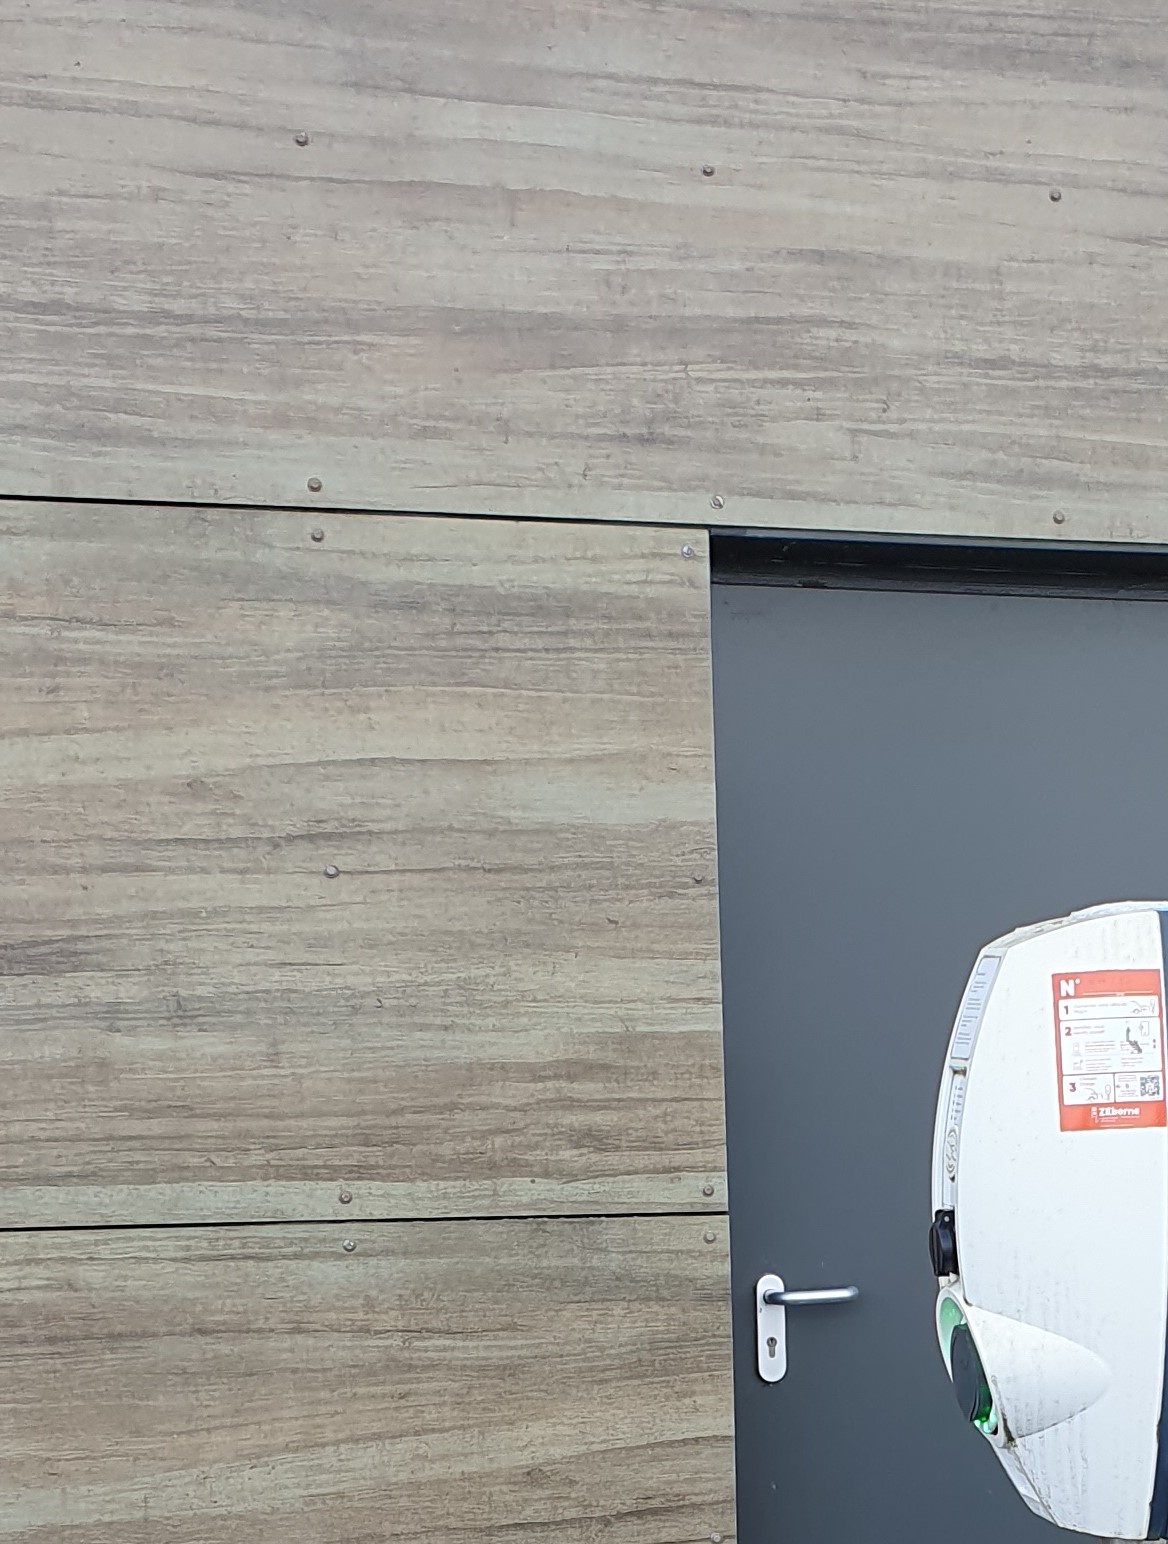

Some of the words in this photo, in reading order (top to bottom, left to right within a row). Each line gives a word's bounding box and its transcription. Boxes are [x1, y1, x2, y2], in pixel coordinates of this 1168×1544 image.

[1063, 1005, 1069, 1015] 1
[1064, 1026, 1072, 1036] 2
[1069, 1082, 1077, 1092] 3
